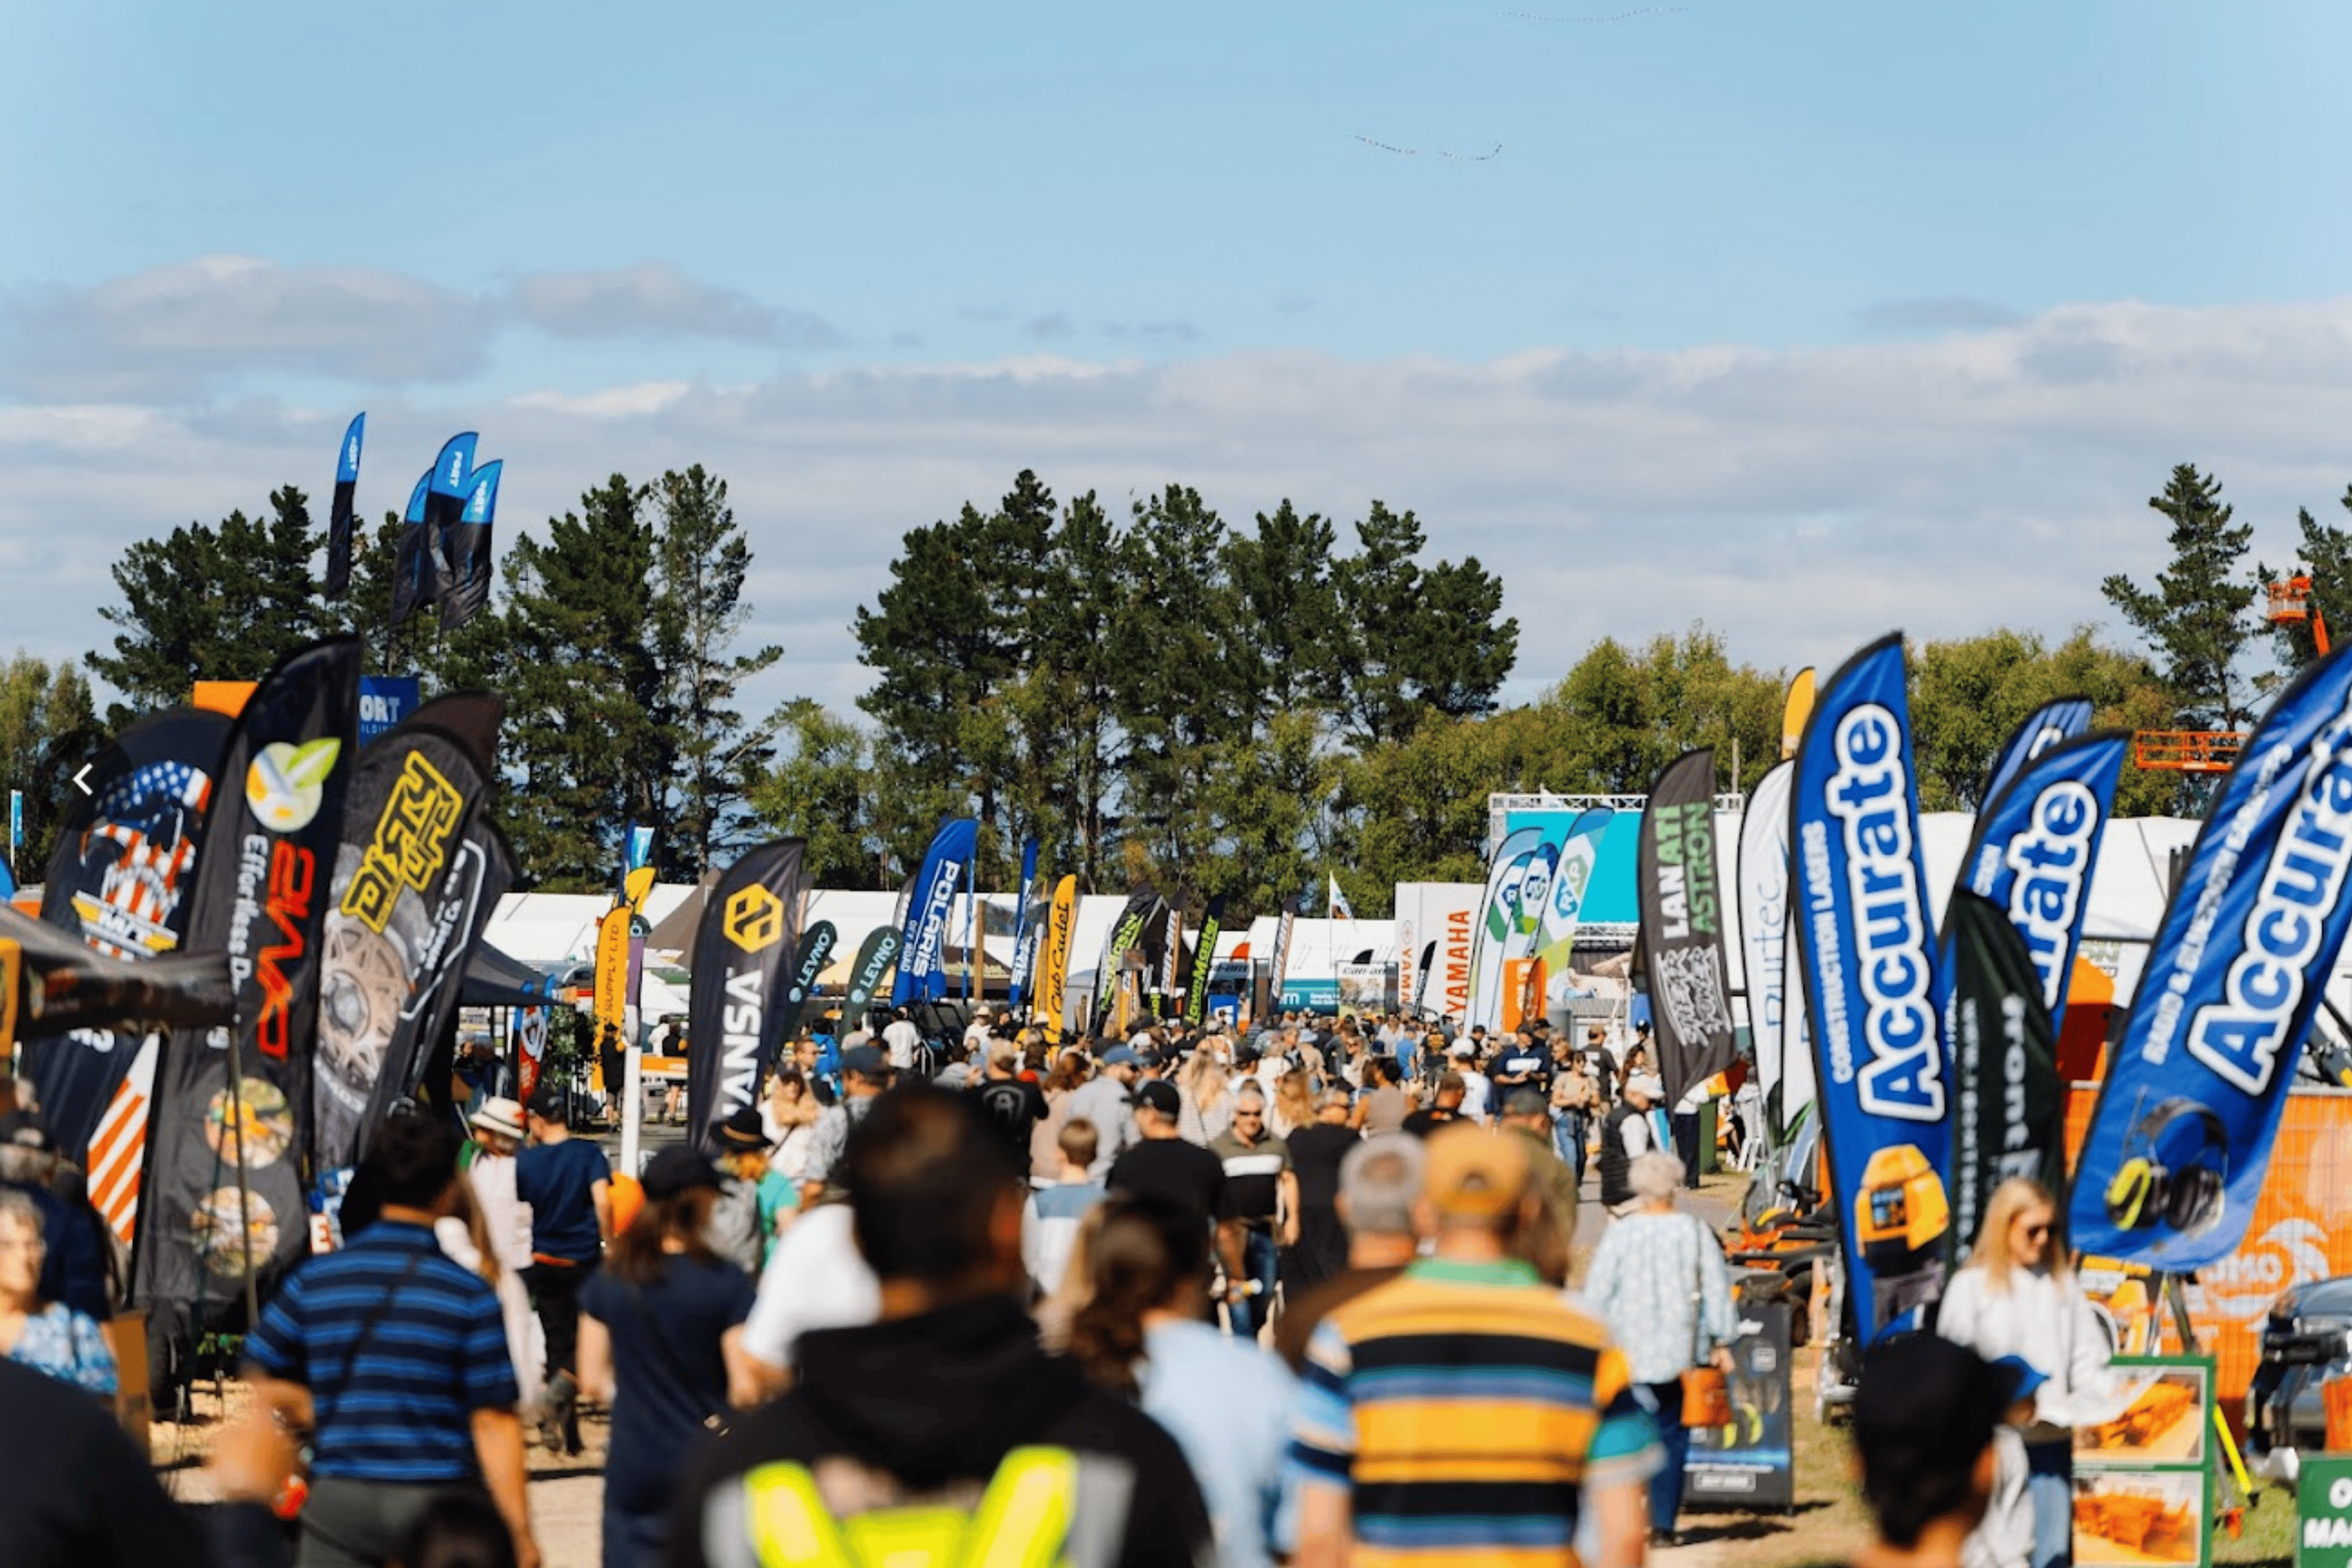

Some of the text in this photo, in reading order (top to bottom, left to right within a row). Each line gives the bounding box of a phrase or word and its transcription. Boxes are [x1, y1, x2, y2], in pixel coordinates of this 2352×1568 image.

[359, 694, 401, 724] ORT
[227, 833, 269, 956] Effortless
[913, 860, 961, 978] POLARIS
[1683, 802, 1717, 934] ASTRON
[1826, 703, 1945, 1121] Accurate
[2008, 780, 2098, 989] rate
[2187, 688, 2352, 1095] Accura
[797, 930, 831, 987] LEVNO
[859, 934, 897, 990] LEVNO
[1050, 900, 1071, 1015] Cub Cadet
[1400, 948, 1412, 1004] YAMA
[1446, 910, 1471, 1014] YAMAHA
[1801, 821, 1855, 1084] CONSTRUCTION LASERS
[721, 967, 763, 1115] ANSA
[2303, 1516, 2352, 1549] MA
